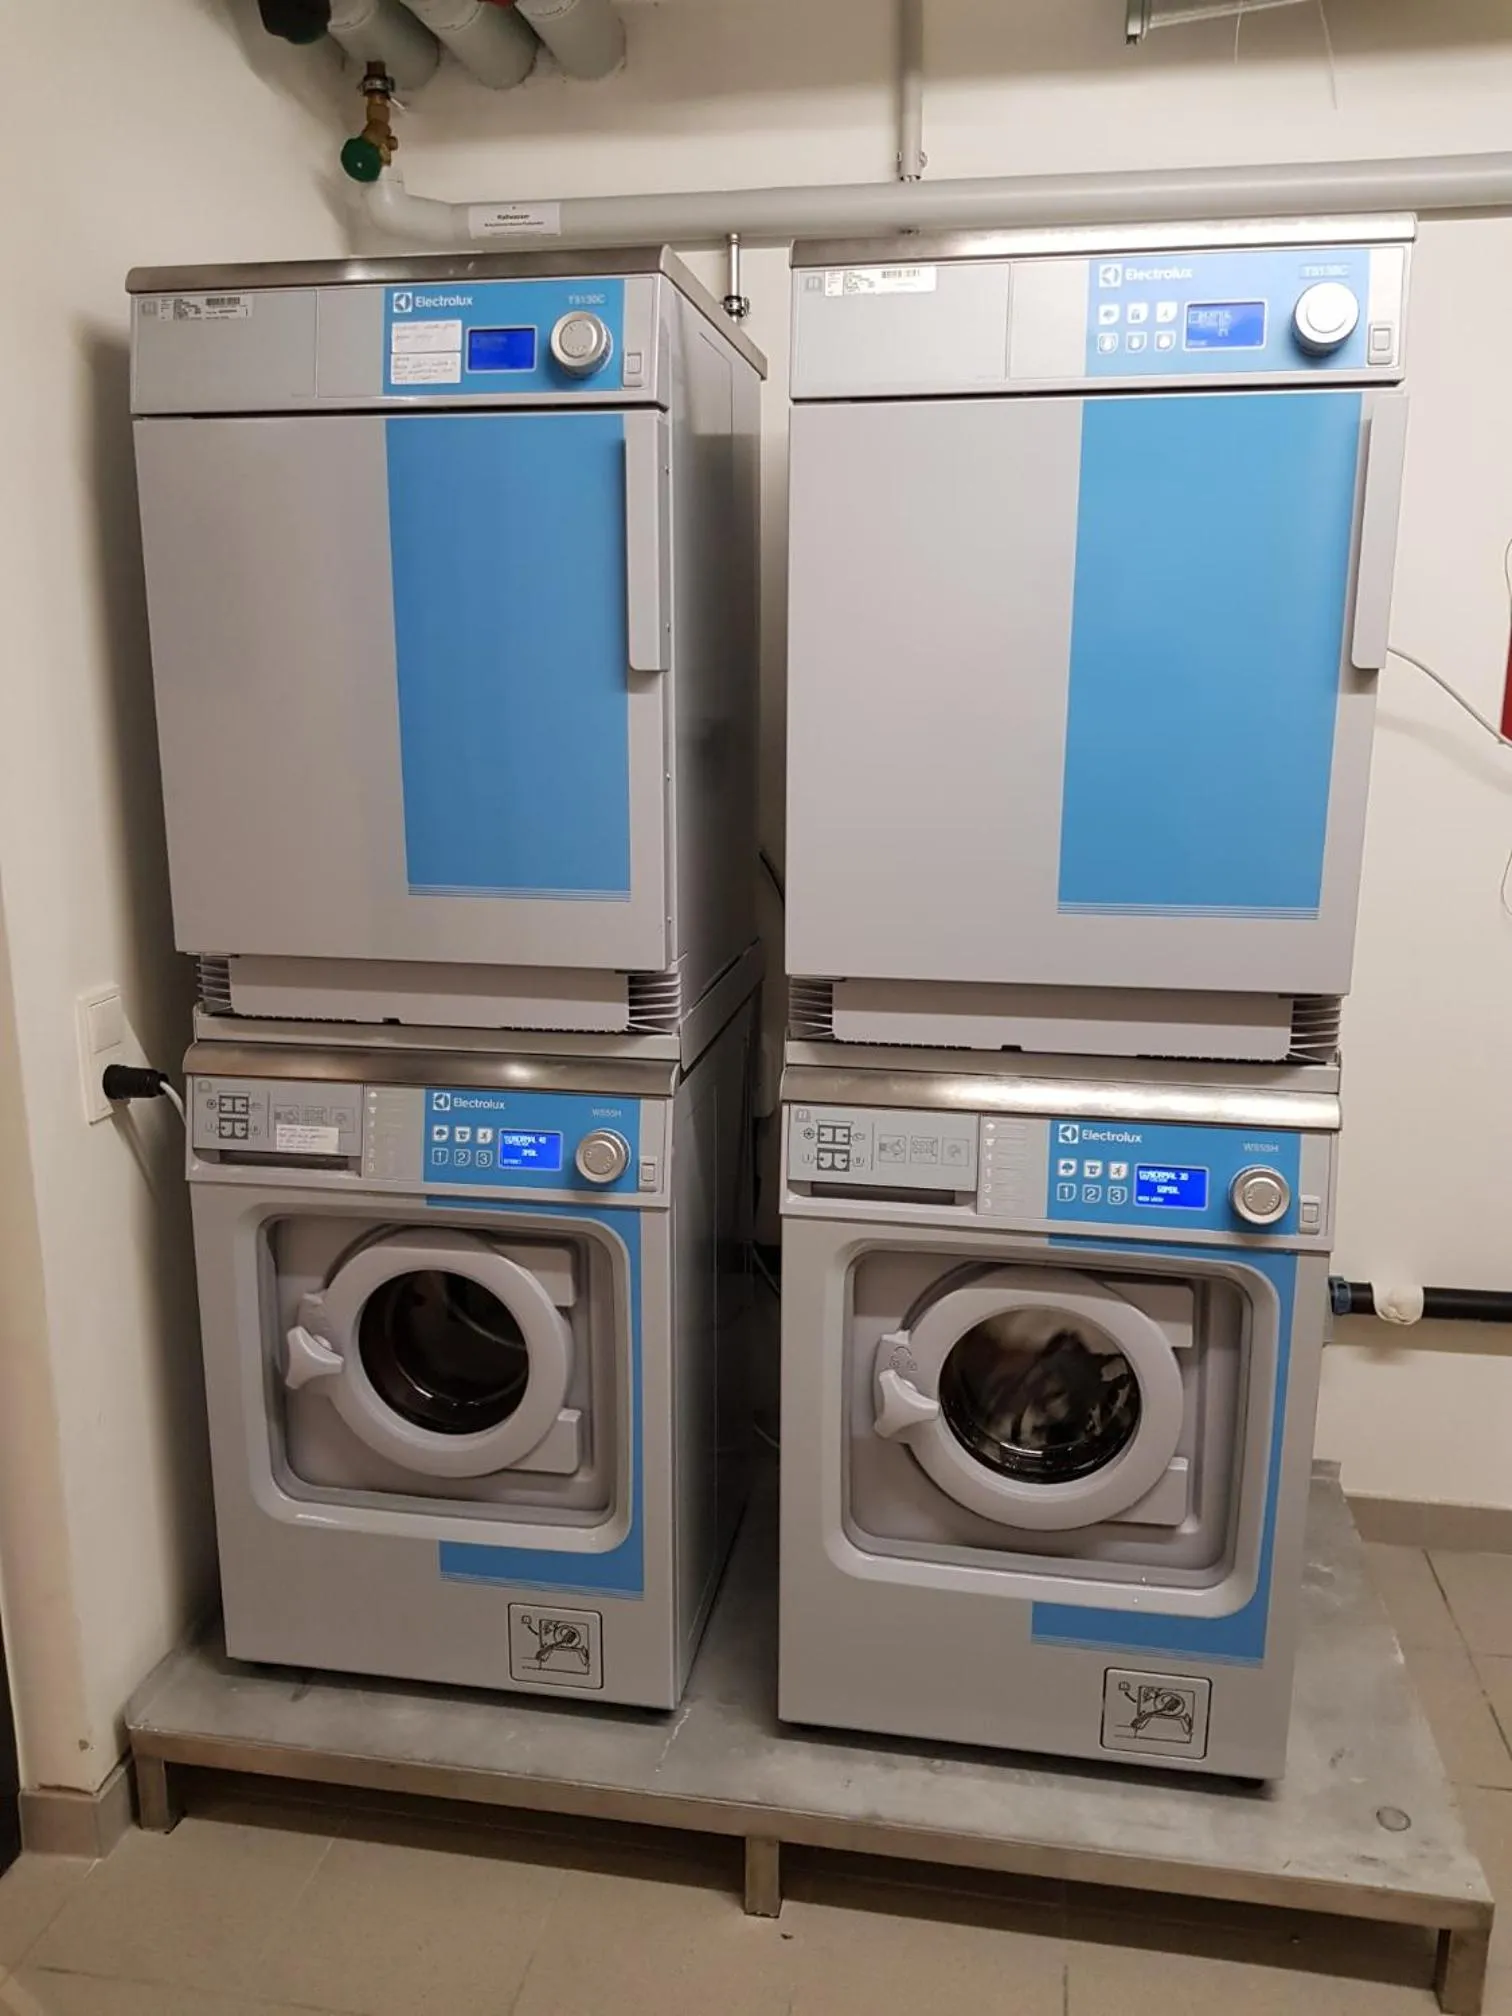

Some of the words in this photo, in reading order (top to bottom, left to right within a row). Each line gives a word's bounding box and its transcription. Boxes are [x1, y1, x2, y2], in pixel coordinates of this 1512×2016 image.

[1125, 265, 1193, 281] Electrolux
[414, 294, 473, 308] Electrolux
[453, 1097, 506, 1110] Electrolux
[1081, 1128, 1143, 1143] Electrolux
[479, 1153, 489, 1165] 3
[1111, 1189, 1121, 1202] 3
